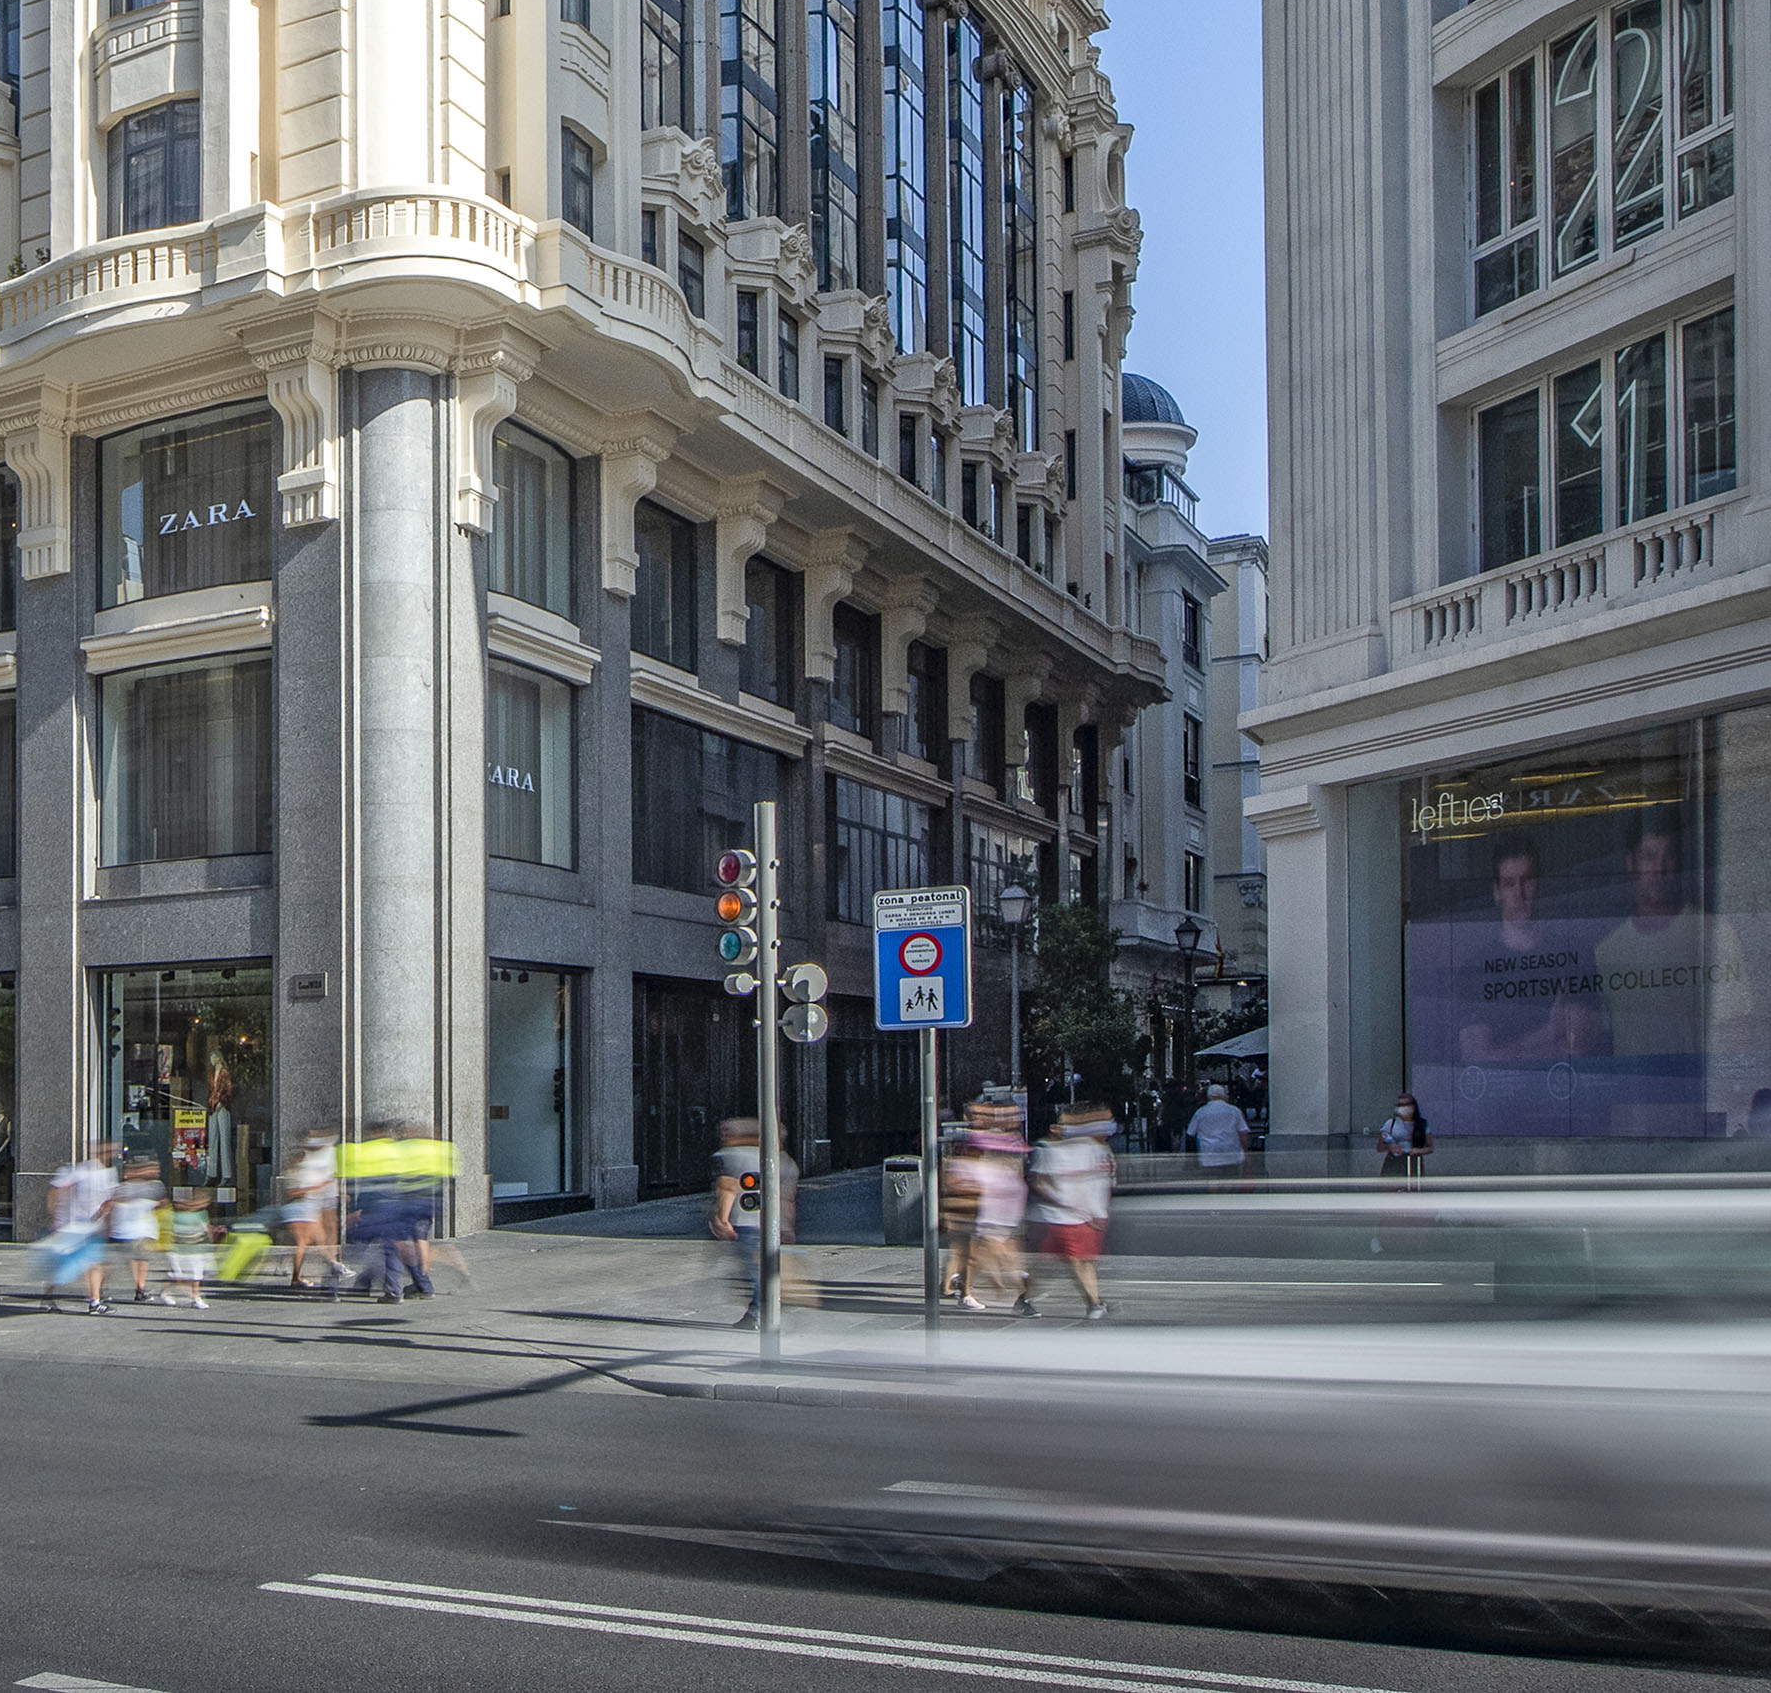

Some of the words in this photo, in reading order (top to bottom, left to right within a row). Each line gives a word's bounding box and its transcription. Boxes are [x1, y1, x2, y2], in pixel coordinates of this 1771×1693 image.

[159, 499, 257, 535] ZARA
[488, 762, 535, 793] ARA
[1411, 792, 1504, 833] lefties
[879, 896, 904, 905] zona
[911, 891, 960, 905] peatonal
[1484, 957, 1517, 974] NEW
[1519, 951, 1578, 972] SEASON
[1484, 974, 1604, 1001] SPORTSWEAR
[1608, 963, 1742, 992] COLLECTON
